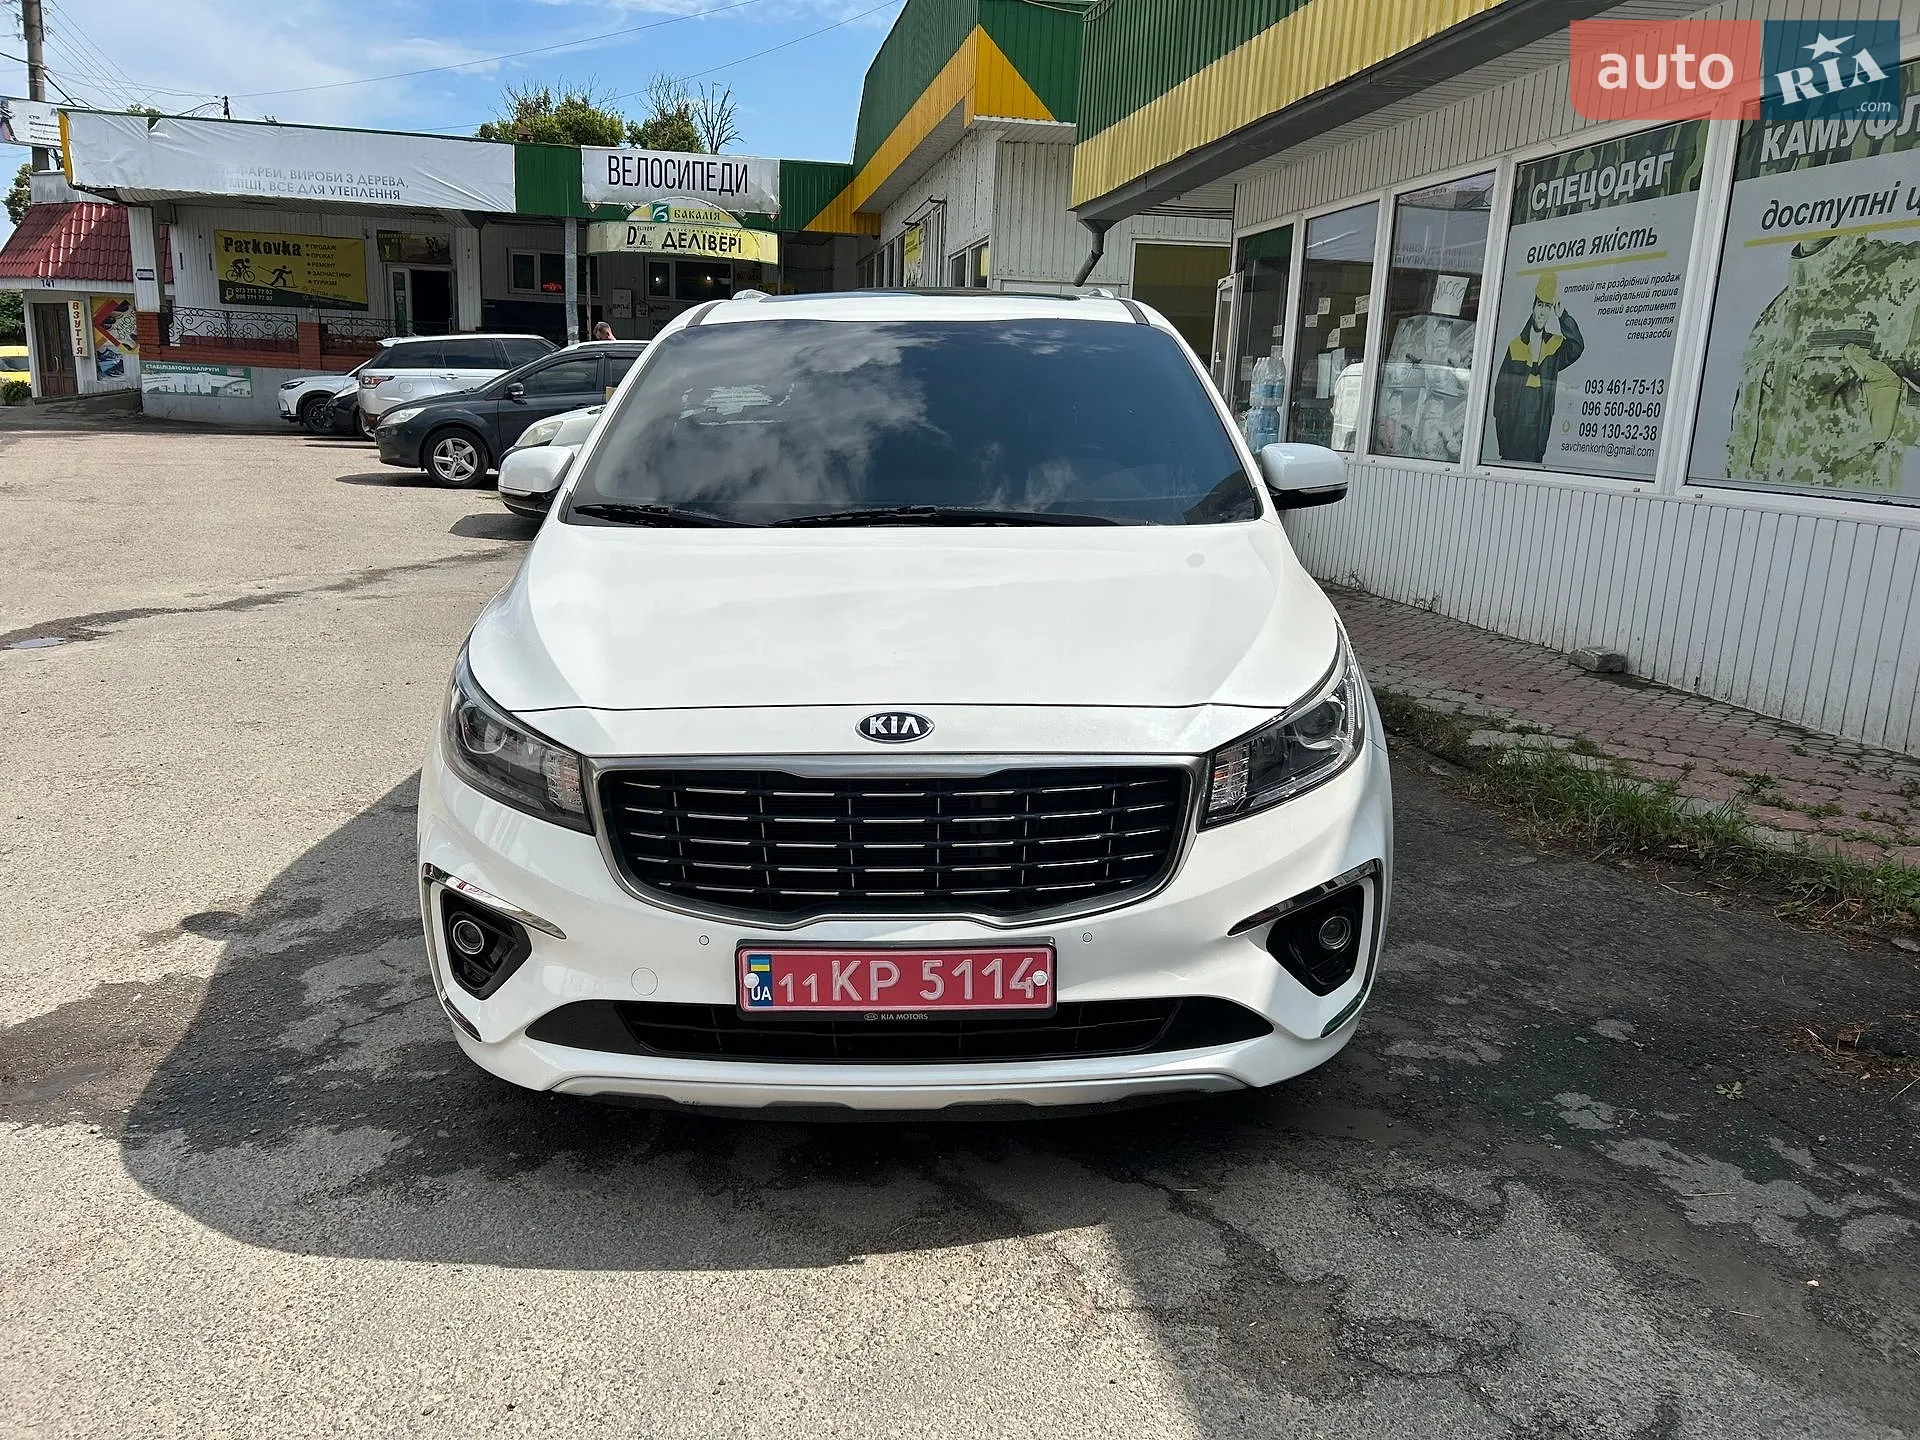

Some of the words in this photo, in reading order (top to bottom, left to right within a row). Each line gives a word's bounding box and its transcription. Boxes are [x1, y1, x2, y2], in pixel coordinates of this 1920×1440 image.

[289, 168, 344, 184] ВИРОБИ
[356, 173, 410, 190] ДЕРЕВА,
[607, 154, 749, 197] ВЕЛОСИПЕДИ
[1531, 151, 1675, 211] СПЕЦОДЯГ
[269, 181, 294, 193] ВСЕ
[296, 182, 325, 196] ДЛЯ
[328, 184, 401, 200] УТЕПЛЕННЯ
[673, 209, 721, 221] БАКАЛІЯ
[1761, 180, 1902, 231] доступні
[223, 236, 302, 257] Parkovka
[661, 231, 742, 254] ДЕЛІВЕРІ
[1526, 237, 1587, 264] висока
[1588, 225, 1659, 256] якість
[1563, 281, 1595, 294] оптовий
[1595, 281, 1607, 290] та
[1606, 275, 1650, 292] роздрібний
[1650, 271, 1682, 286] продаж
[1593, 288, 1651, 304] індивідуальний
[1651, 286, 1680, 299] пошив
[1597, 304, 1625, 316] повний
[1624, 301, 1677, 315] асортимент
[72, 301, 84, 355] ВЗУТТЯ
[1624, 315, 1675, 331] спецвзуття
[1626, 327, 1673, 341] спецзасоби
[1584, 378, 1604, 395] 093
[1606, 378, 1665, 395] 461-75-13
[1581, 401, 1601, 416] 096
[1603, 401, 1661, 418] 560-80-60
[1578, 422, 1598, 438] 099
[1601, 423, 1658, 441] 130-32-38
[1560, 441, 1655, 458] savchenkorh@gmail.com
[868, 715, 921, 735] KIA
[919, 957, 1034, 1001] 5114
[751, 985, 773, 1001] UA
